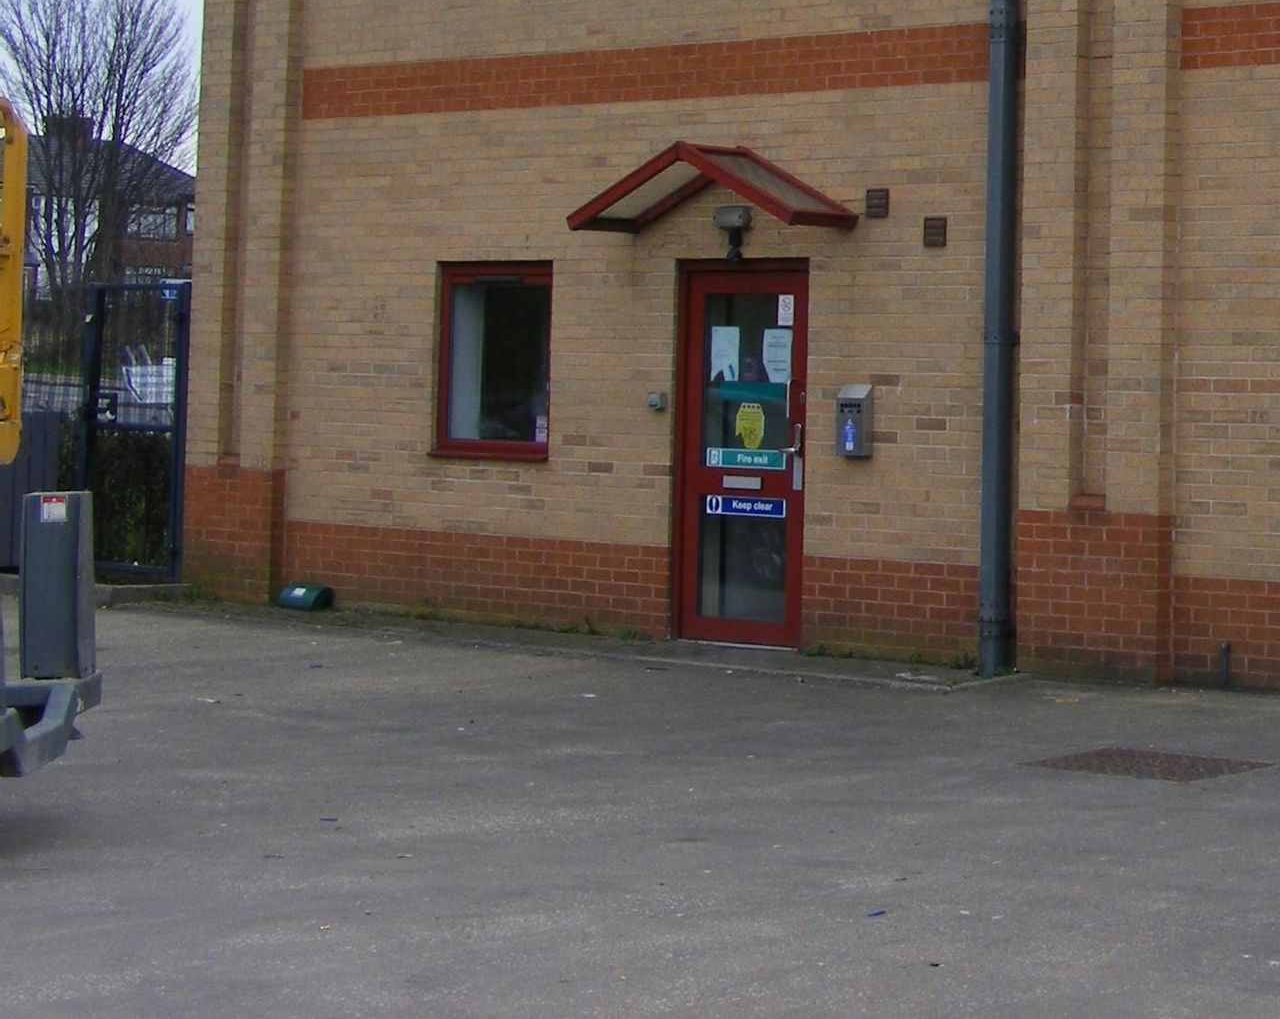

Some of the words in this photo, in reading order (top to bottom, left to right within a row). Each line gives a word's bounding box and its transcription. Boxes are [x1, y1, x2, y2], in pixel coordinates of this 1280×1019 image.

[737, 453, 752, 463] Fire
[753, 455, 768, 465] exit
[732, 499, 752, 512] Keep
[753, 501, 773, 512] clear
